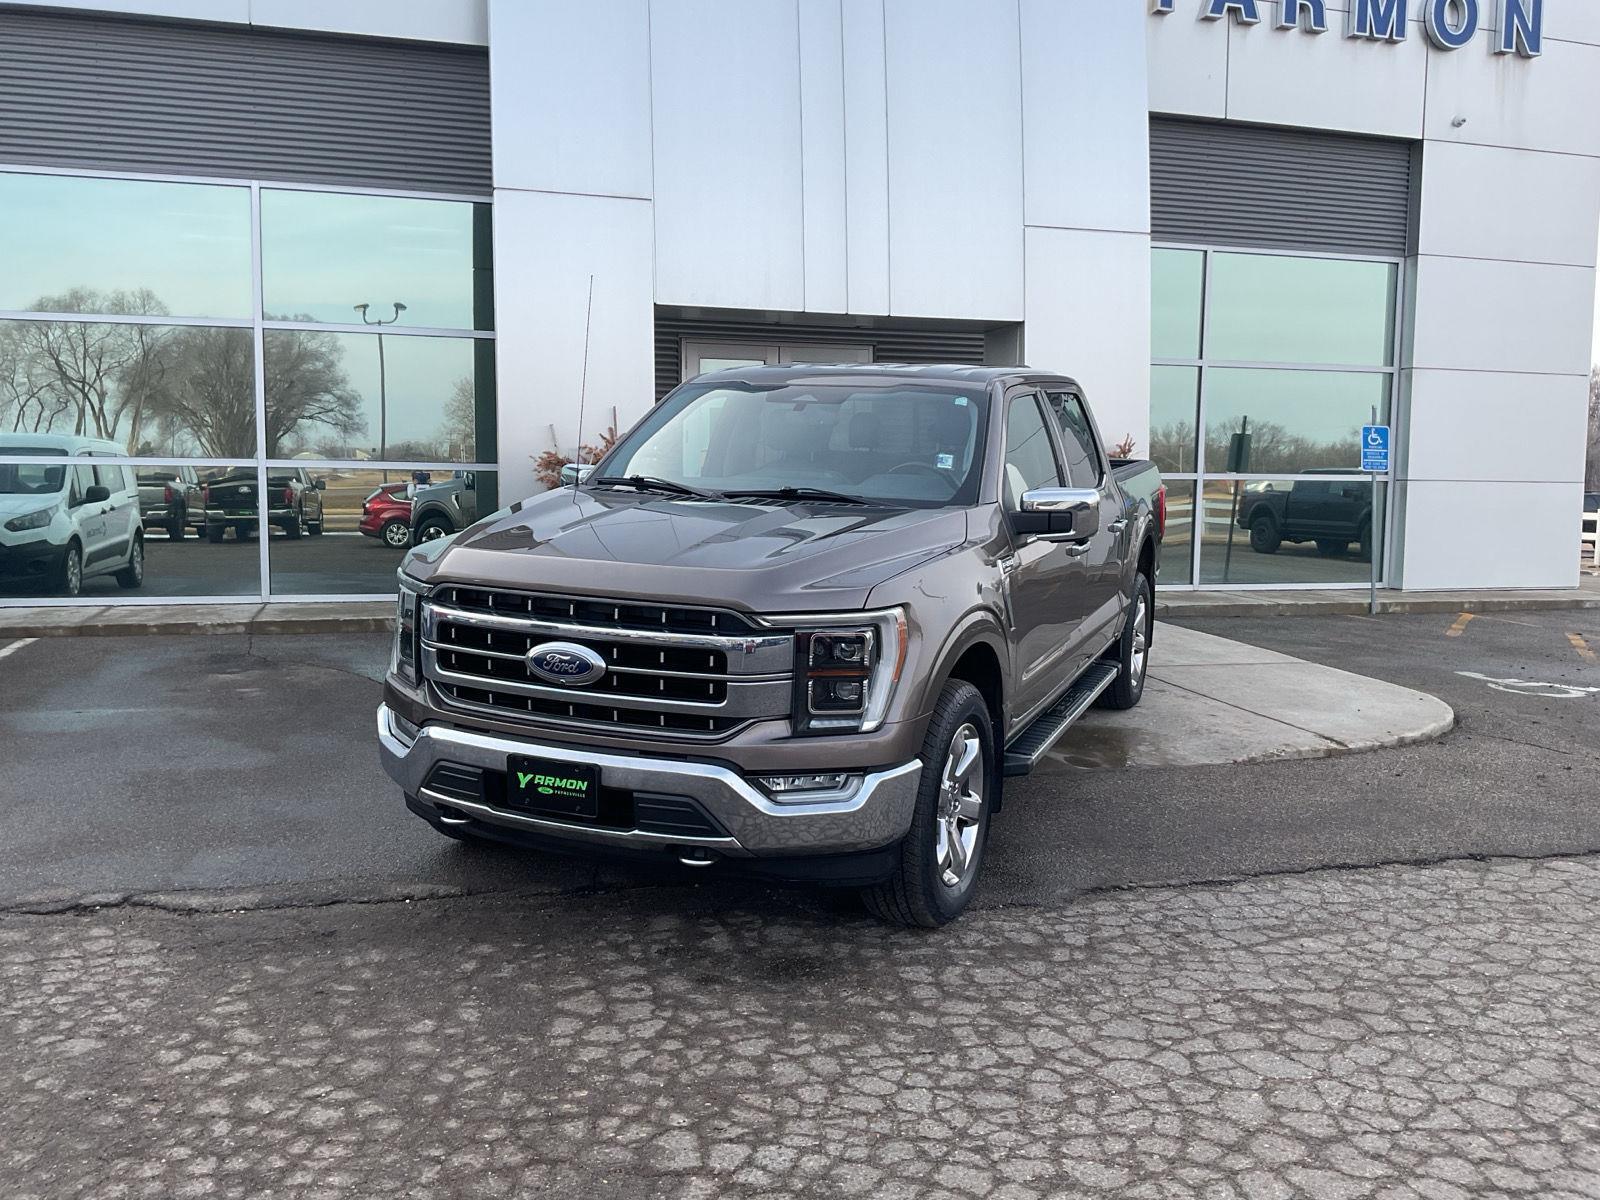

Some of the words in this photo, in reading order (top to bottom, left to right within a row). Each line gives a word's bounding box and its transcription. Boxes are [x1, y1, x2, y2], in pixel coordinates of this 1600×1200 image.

[1151, 0, 1543, 58] MON
[543, 653, 580, 673] Ford
[516, 772, 588, 791] YARMON
